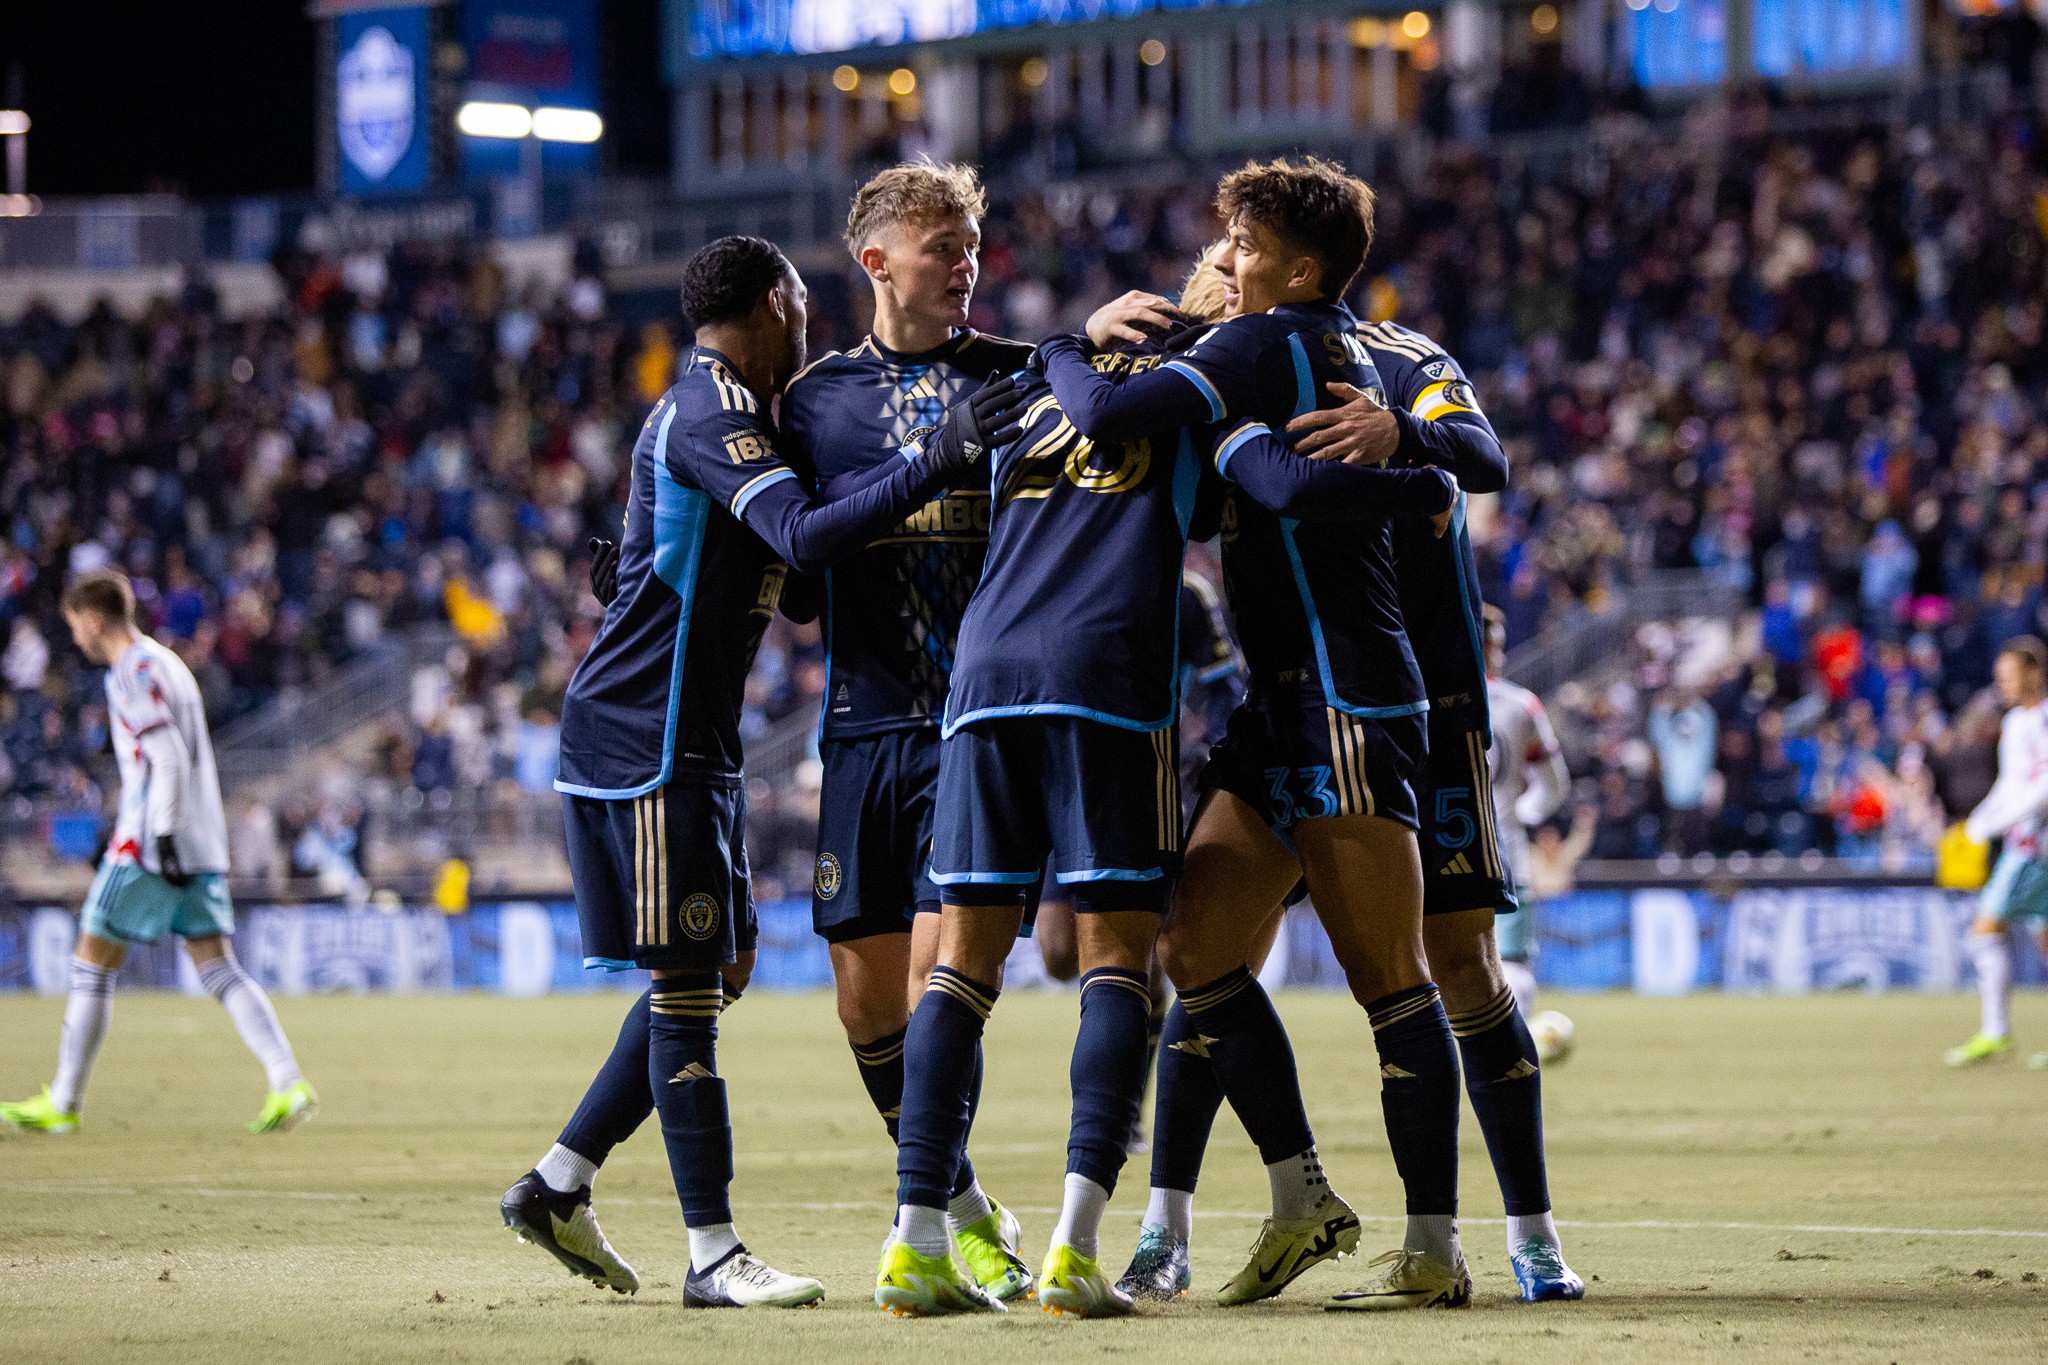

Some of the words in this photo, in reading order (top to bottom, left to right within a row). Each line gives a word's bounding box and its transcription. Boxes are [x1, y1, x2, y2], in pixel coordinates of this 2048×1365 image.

[1264, 765, 1339, 829] 33
[1435, 786, 1475, 848] 5
[1285, 1214, 1360, 1278] AIR
